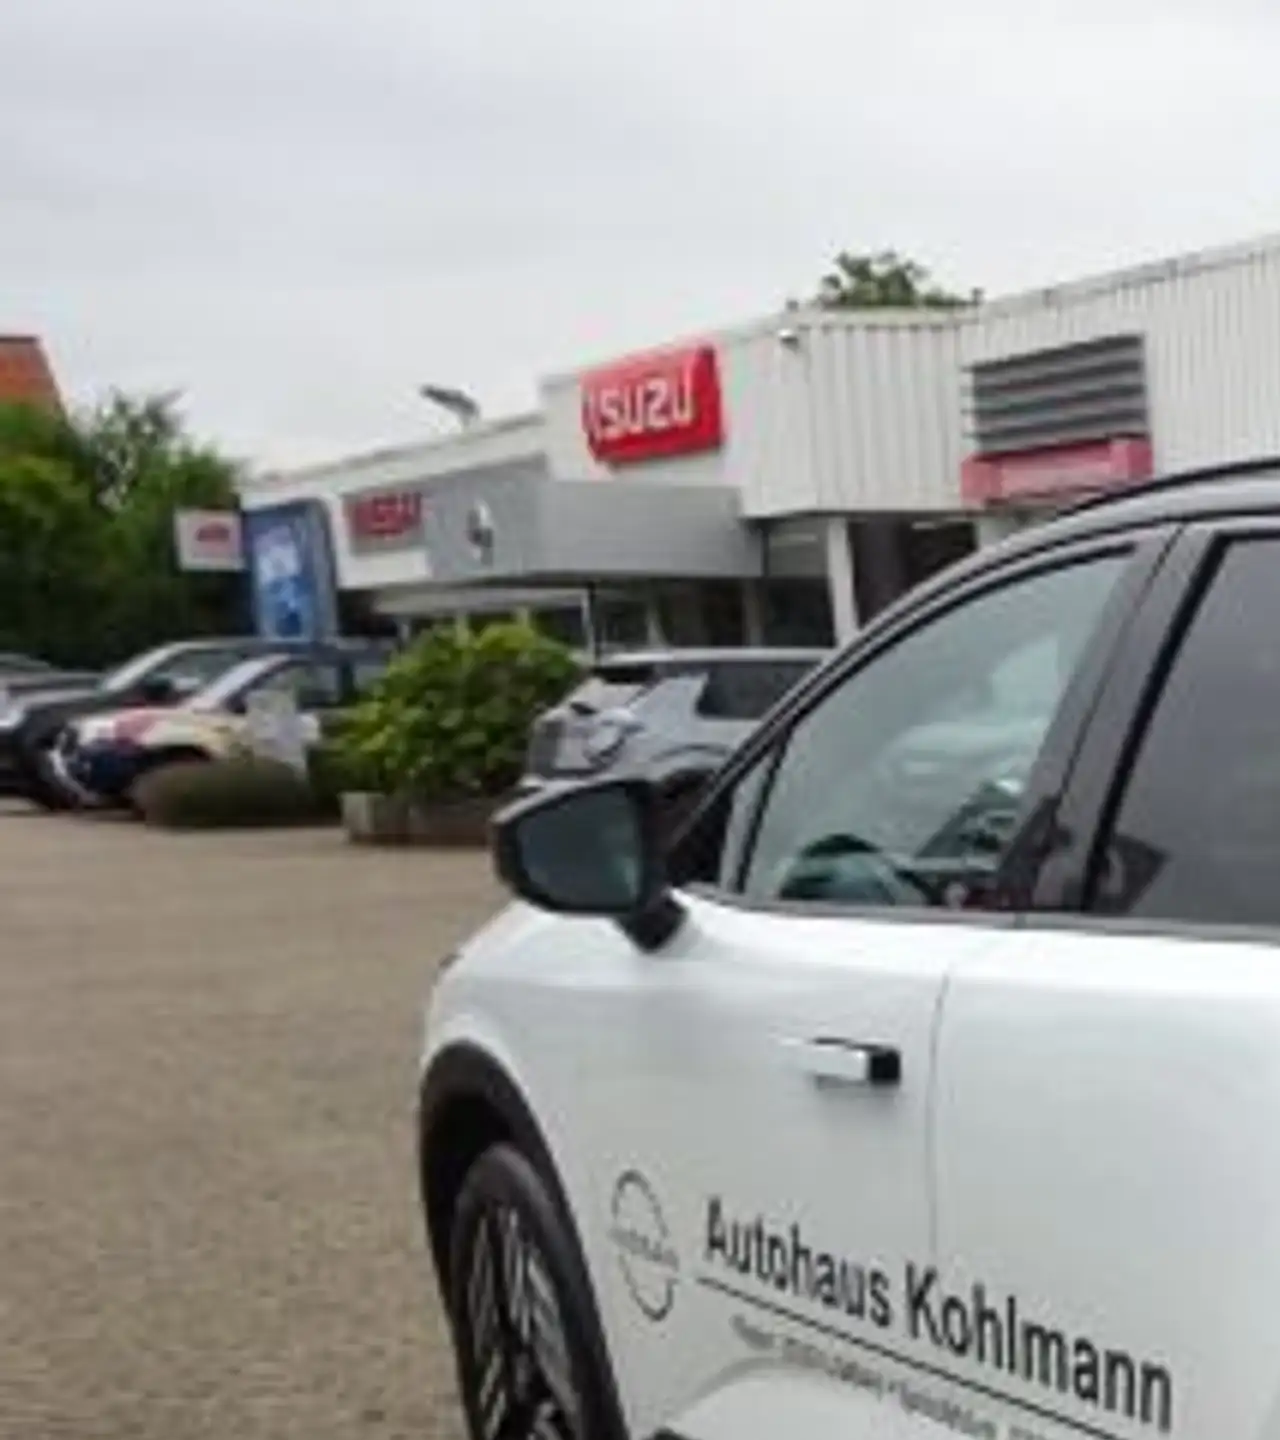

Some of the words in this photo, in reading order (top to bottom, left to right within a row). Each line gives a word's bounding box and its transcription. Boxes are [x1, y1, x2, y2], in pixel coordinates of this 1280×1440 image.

[585, 366, 696, 442] ISUZU
[704, 1196, 891, 1328] Autohaus
[904, 1262, 1173, 1434] Kohlmann
